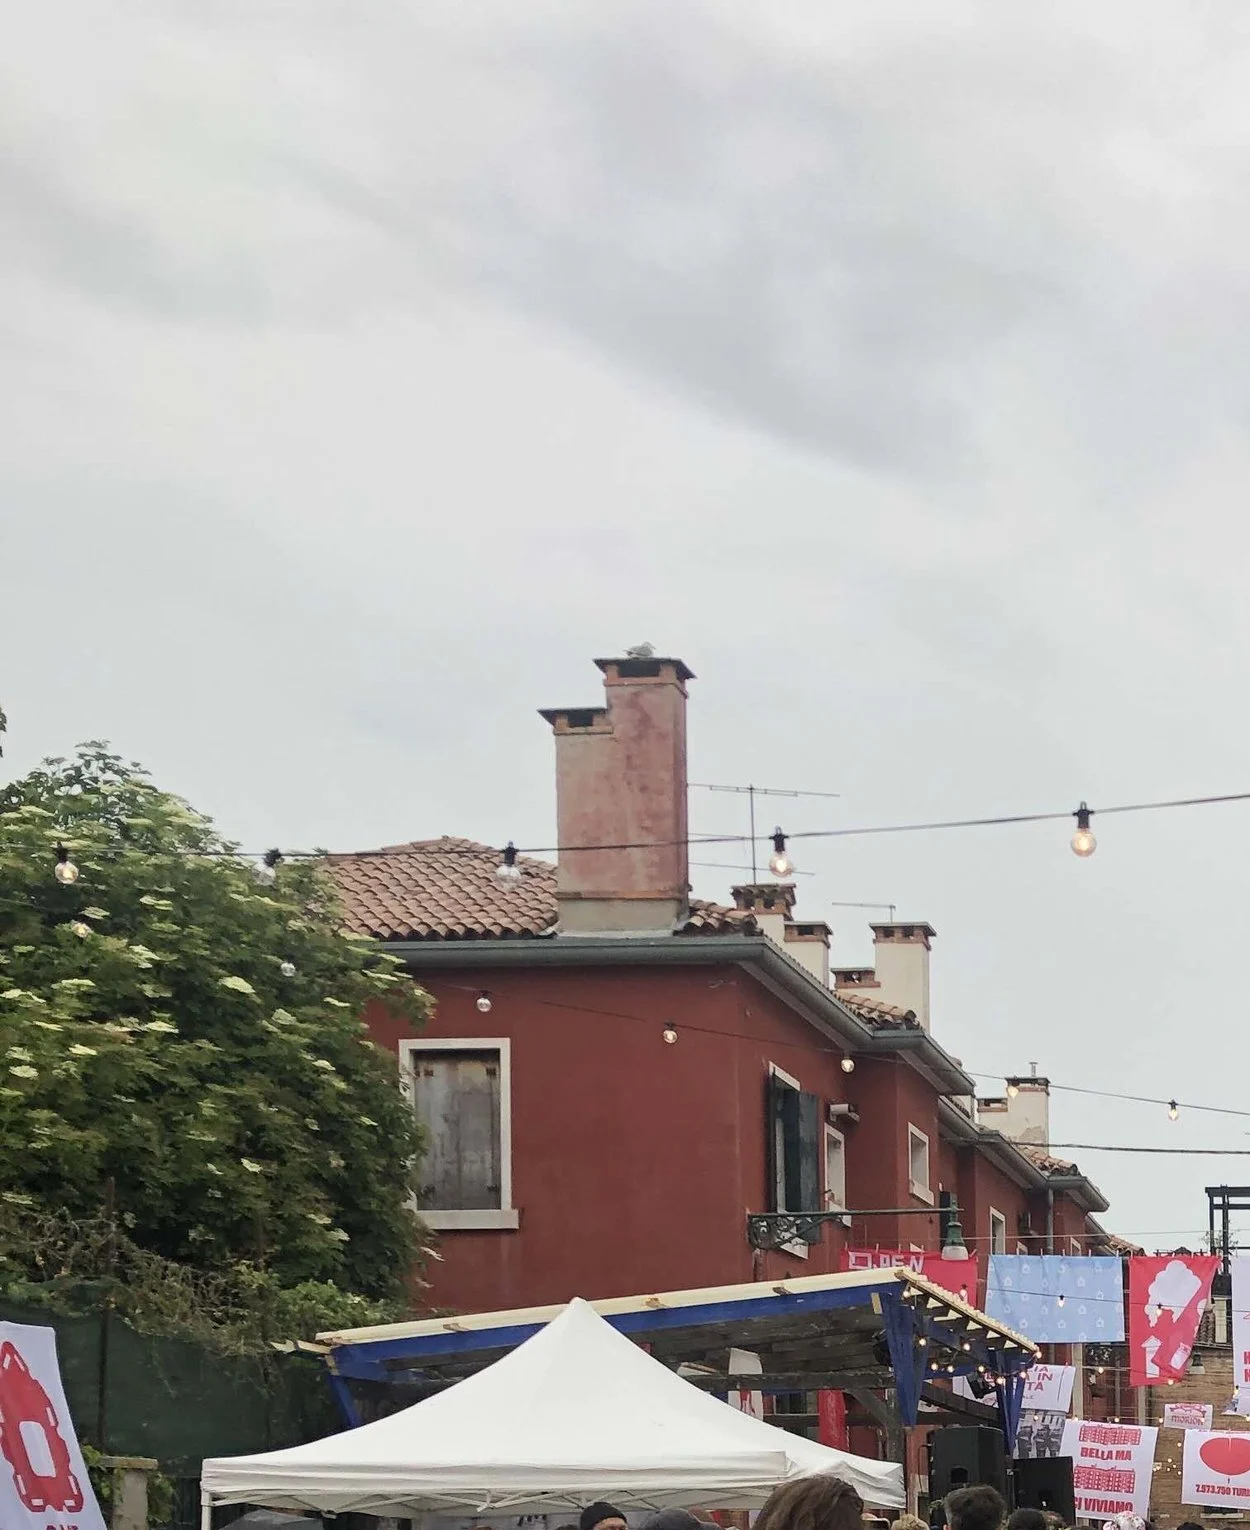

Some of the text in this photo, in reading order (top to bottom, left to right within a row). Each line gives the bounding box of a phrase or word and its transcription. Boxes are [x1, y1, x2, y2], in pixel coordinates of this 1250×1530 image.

[1080, 1447, 1132, 1461] BELLA MA
[1084, 1497, 1134, 1514] VIVIAMO
